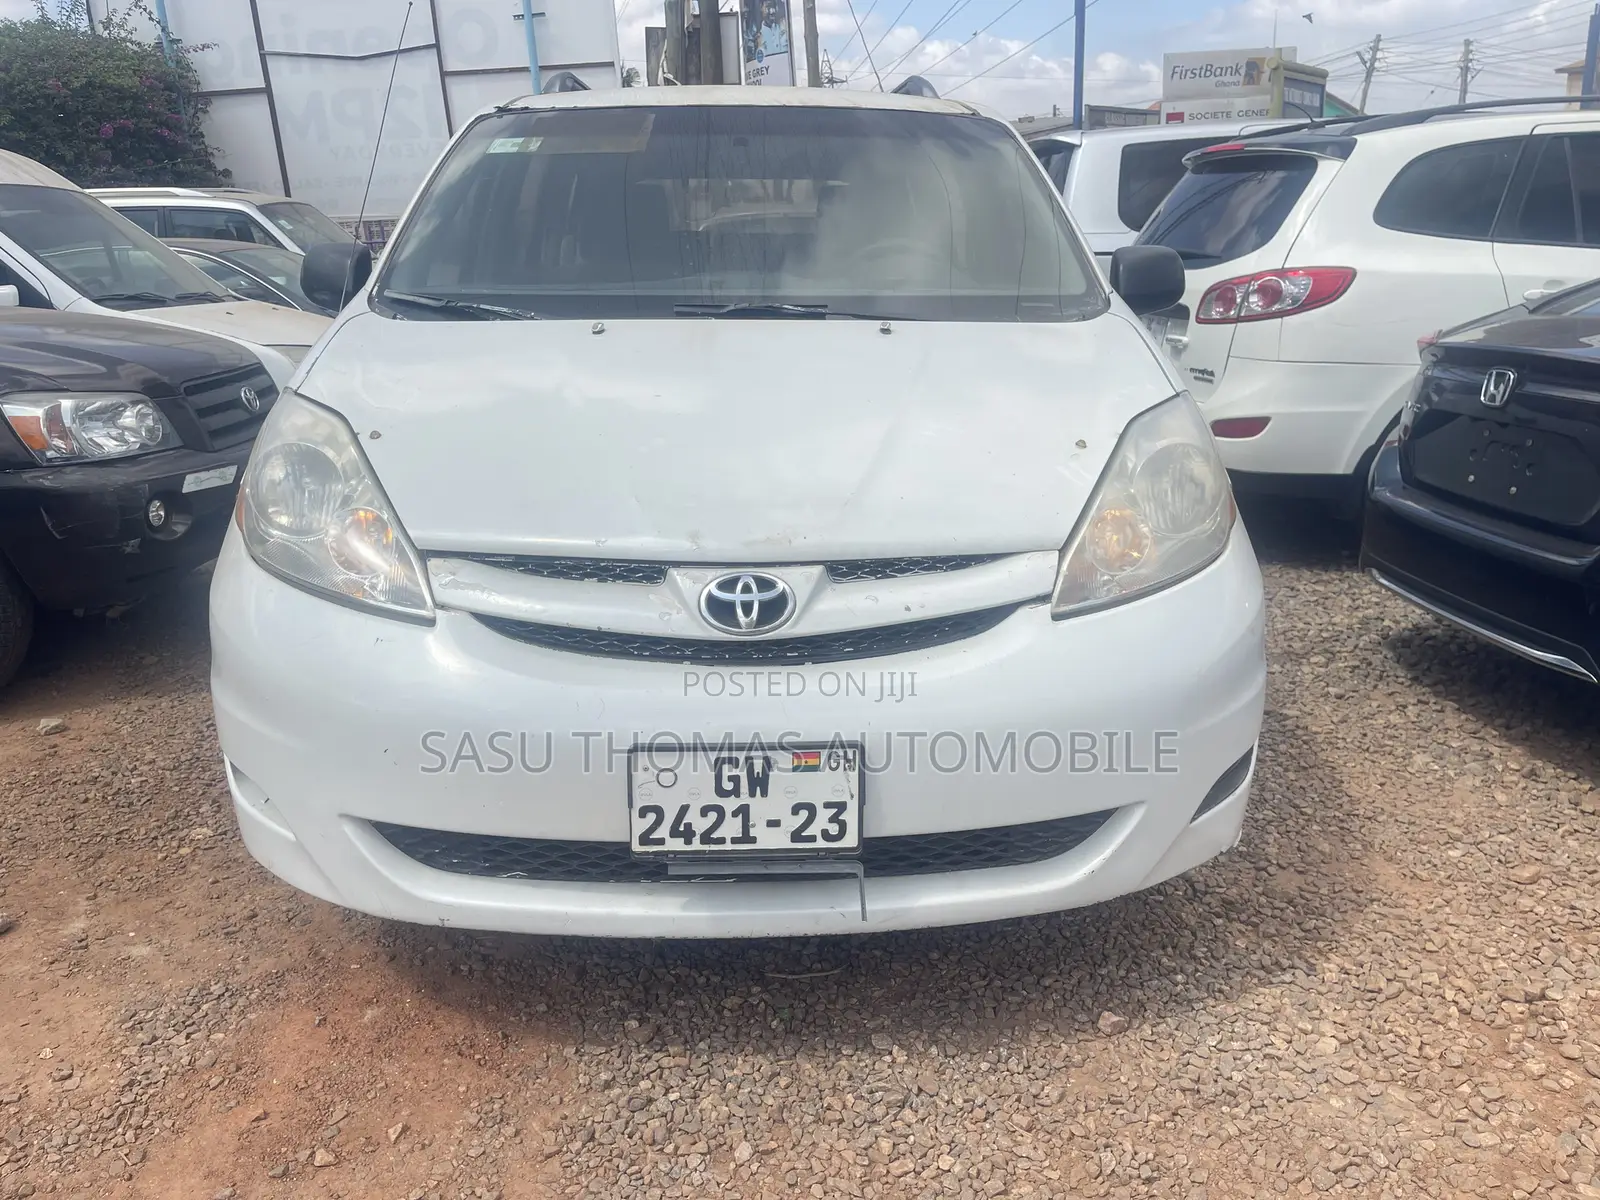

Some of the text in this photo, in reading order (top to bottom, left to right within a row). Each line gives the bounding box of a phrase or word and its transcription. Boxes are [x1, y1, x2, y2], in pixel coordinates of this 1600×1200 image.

[752, 65, 770, 78] GREY
[1171, 62, 1243, 82] FirstBank
[1214, 80, 1241, 88] Ghana
[1188, 110, 1233, 121] SOCIETE
[714, 749, 857, 799] GW GH
[637, 800, 848, 846] 2421-23
